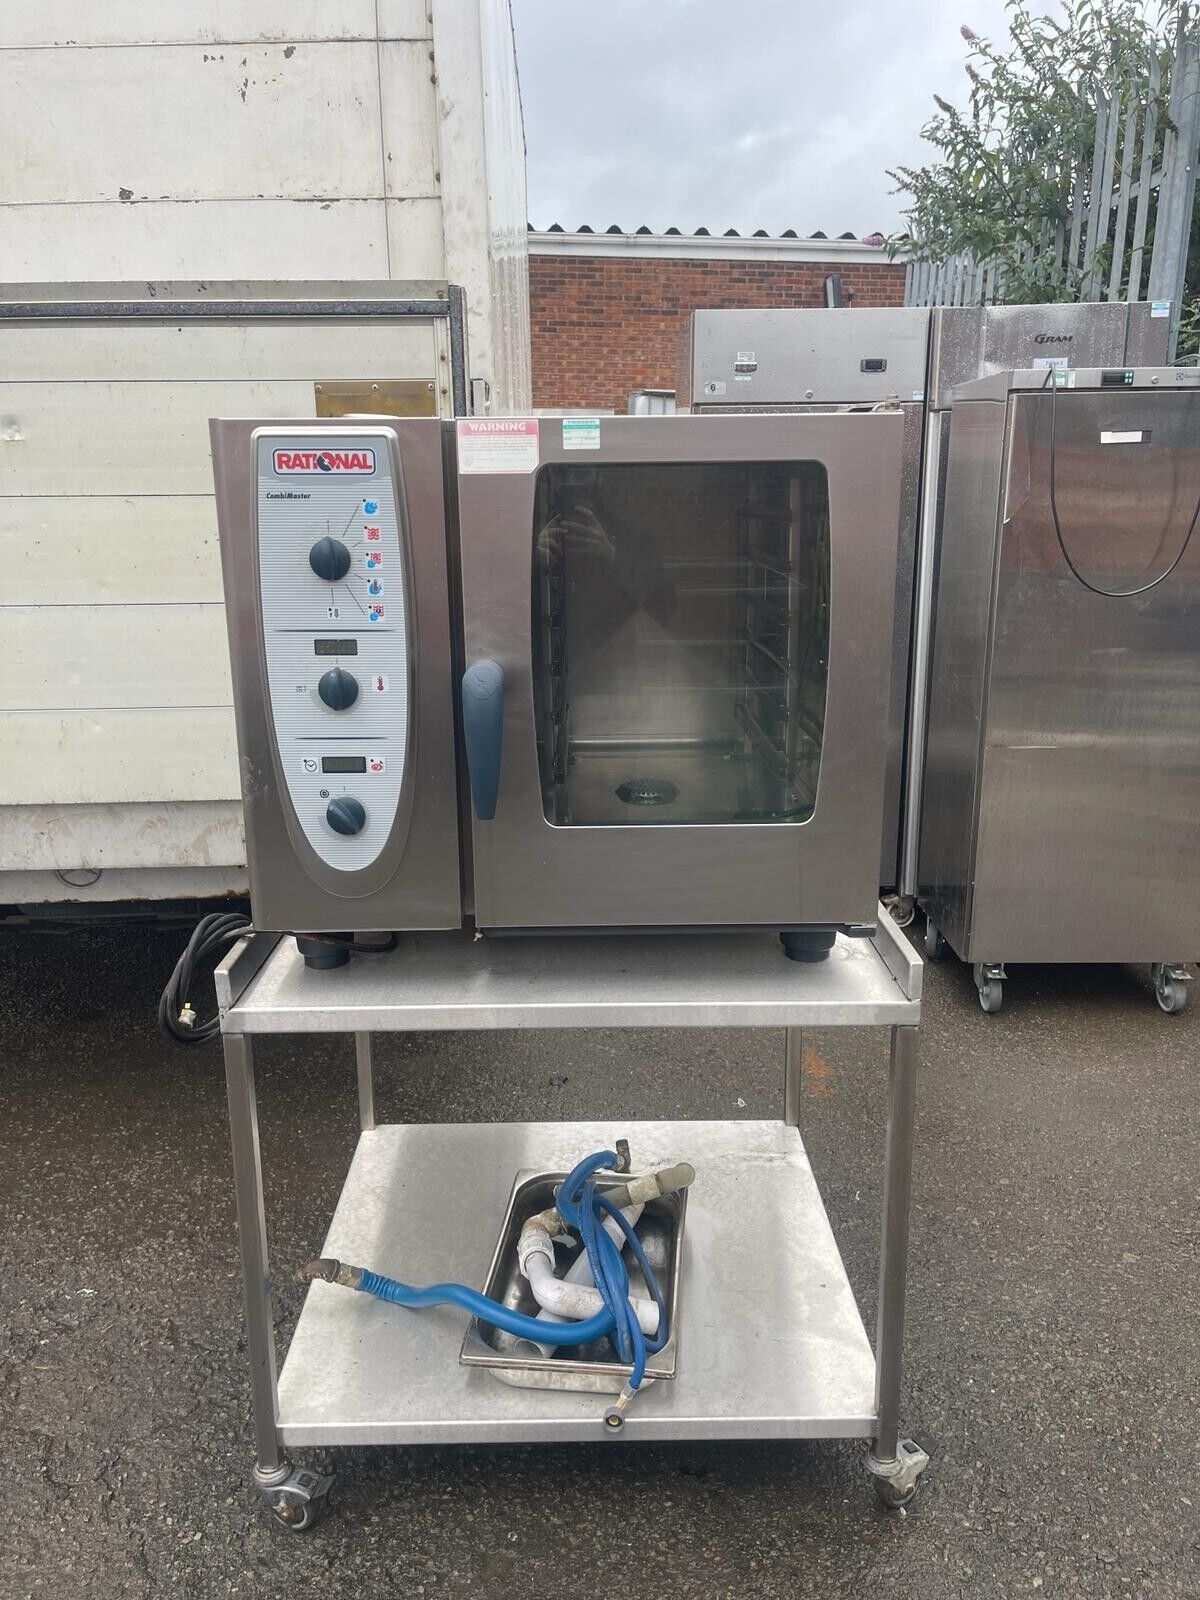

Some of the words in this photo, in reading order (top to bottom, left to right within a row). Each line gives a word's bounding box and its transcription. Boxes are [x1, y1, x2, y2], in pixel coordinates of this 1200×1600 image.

[1034, 333, 1073, 344] GRAM
[468, 422, 526, 431] WARNING
[277, 452, 372, 471] RATIONAL
